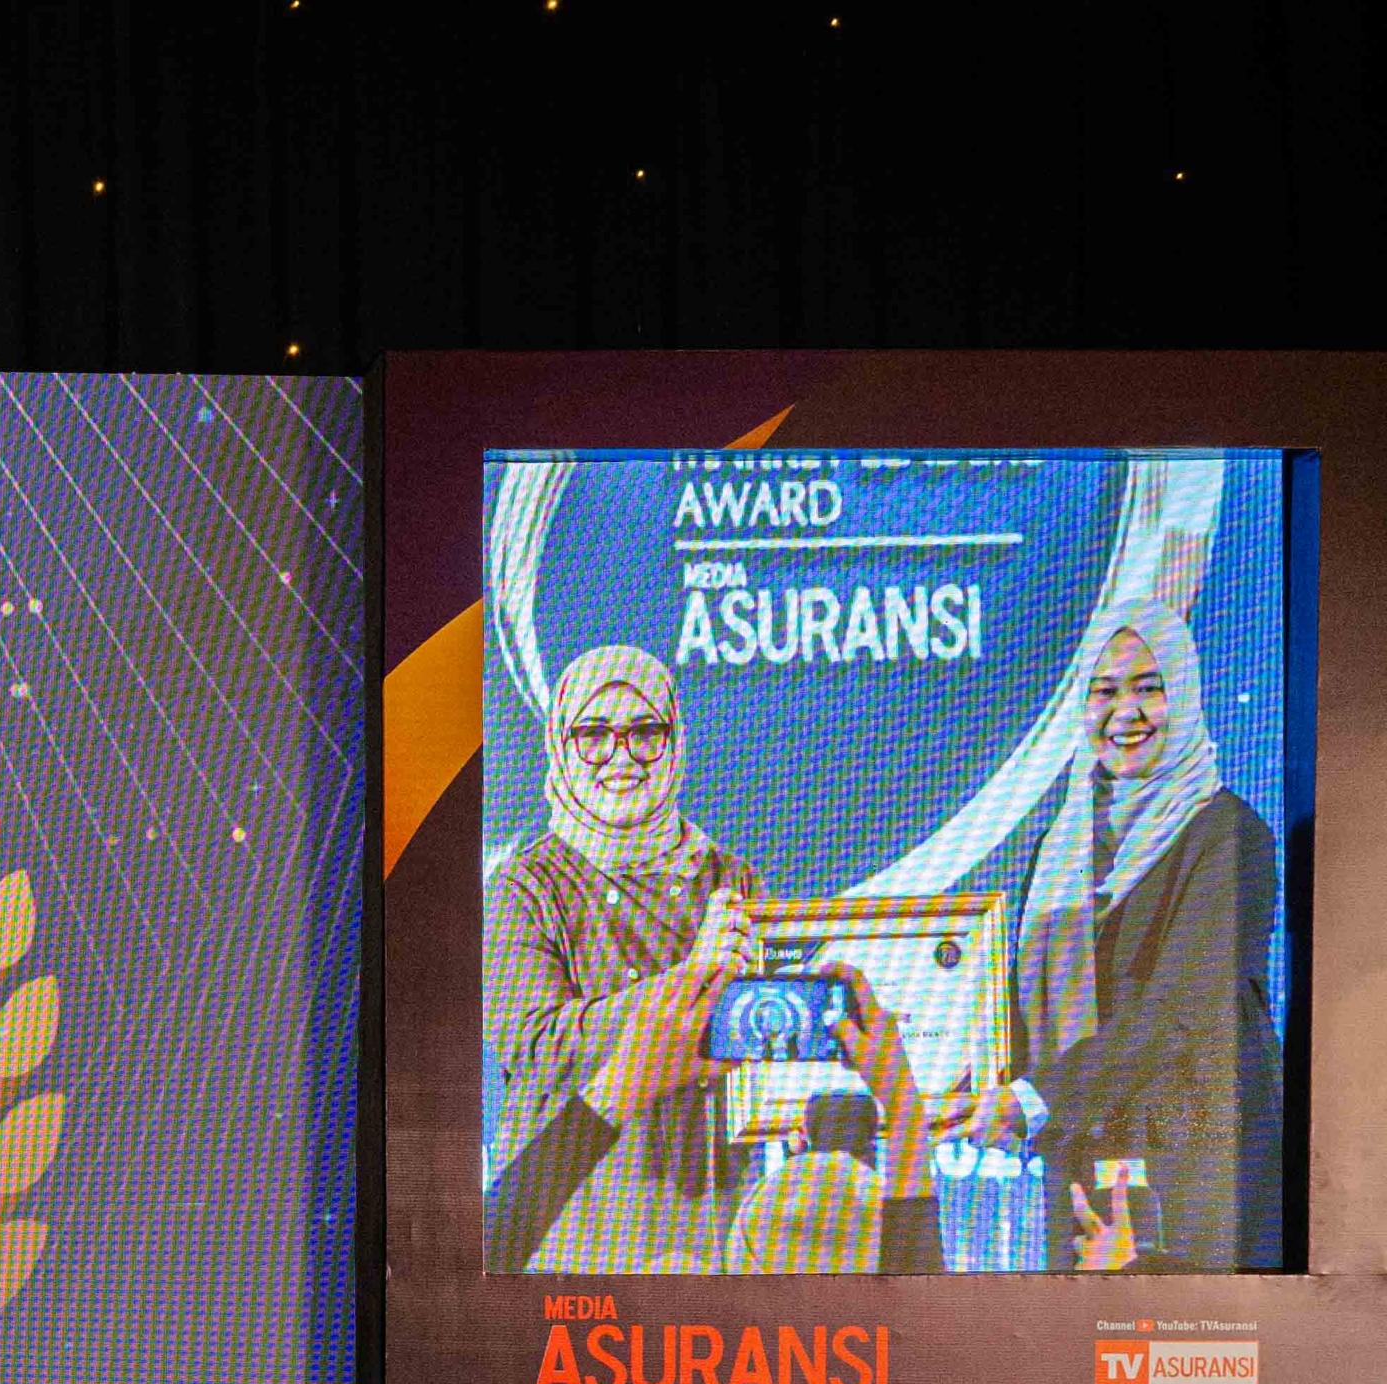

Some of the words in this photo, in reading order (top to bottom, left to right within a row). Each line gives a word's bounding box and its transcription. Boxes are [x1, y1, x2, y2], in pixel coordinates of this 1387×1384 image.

[674, 480, 842, 527] AWARD
[684, 562, 747, 588] MEDIA
[676, 584, 981, 665] ASURANSI
[544, 1295, 618, 1320] MEDIA
[1096, 1320, 1135, 1331] Channel
[1157, 1320, 1198, 1331] YouTube:
[1201, 1320, 1258, 1331] TVAsuransi
[1101, 1353, 1144, 1379] TV
[1153, 1357, 1255, 1378] ASURANSI
